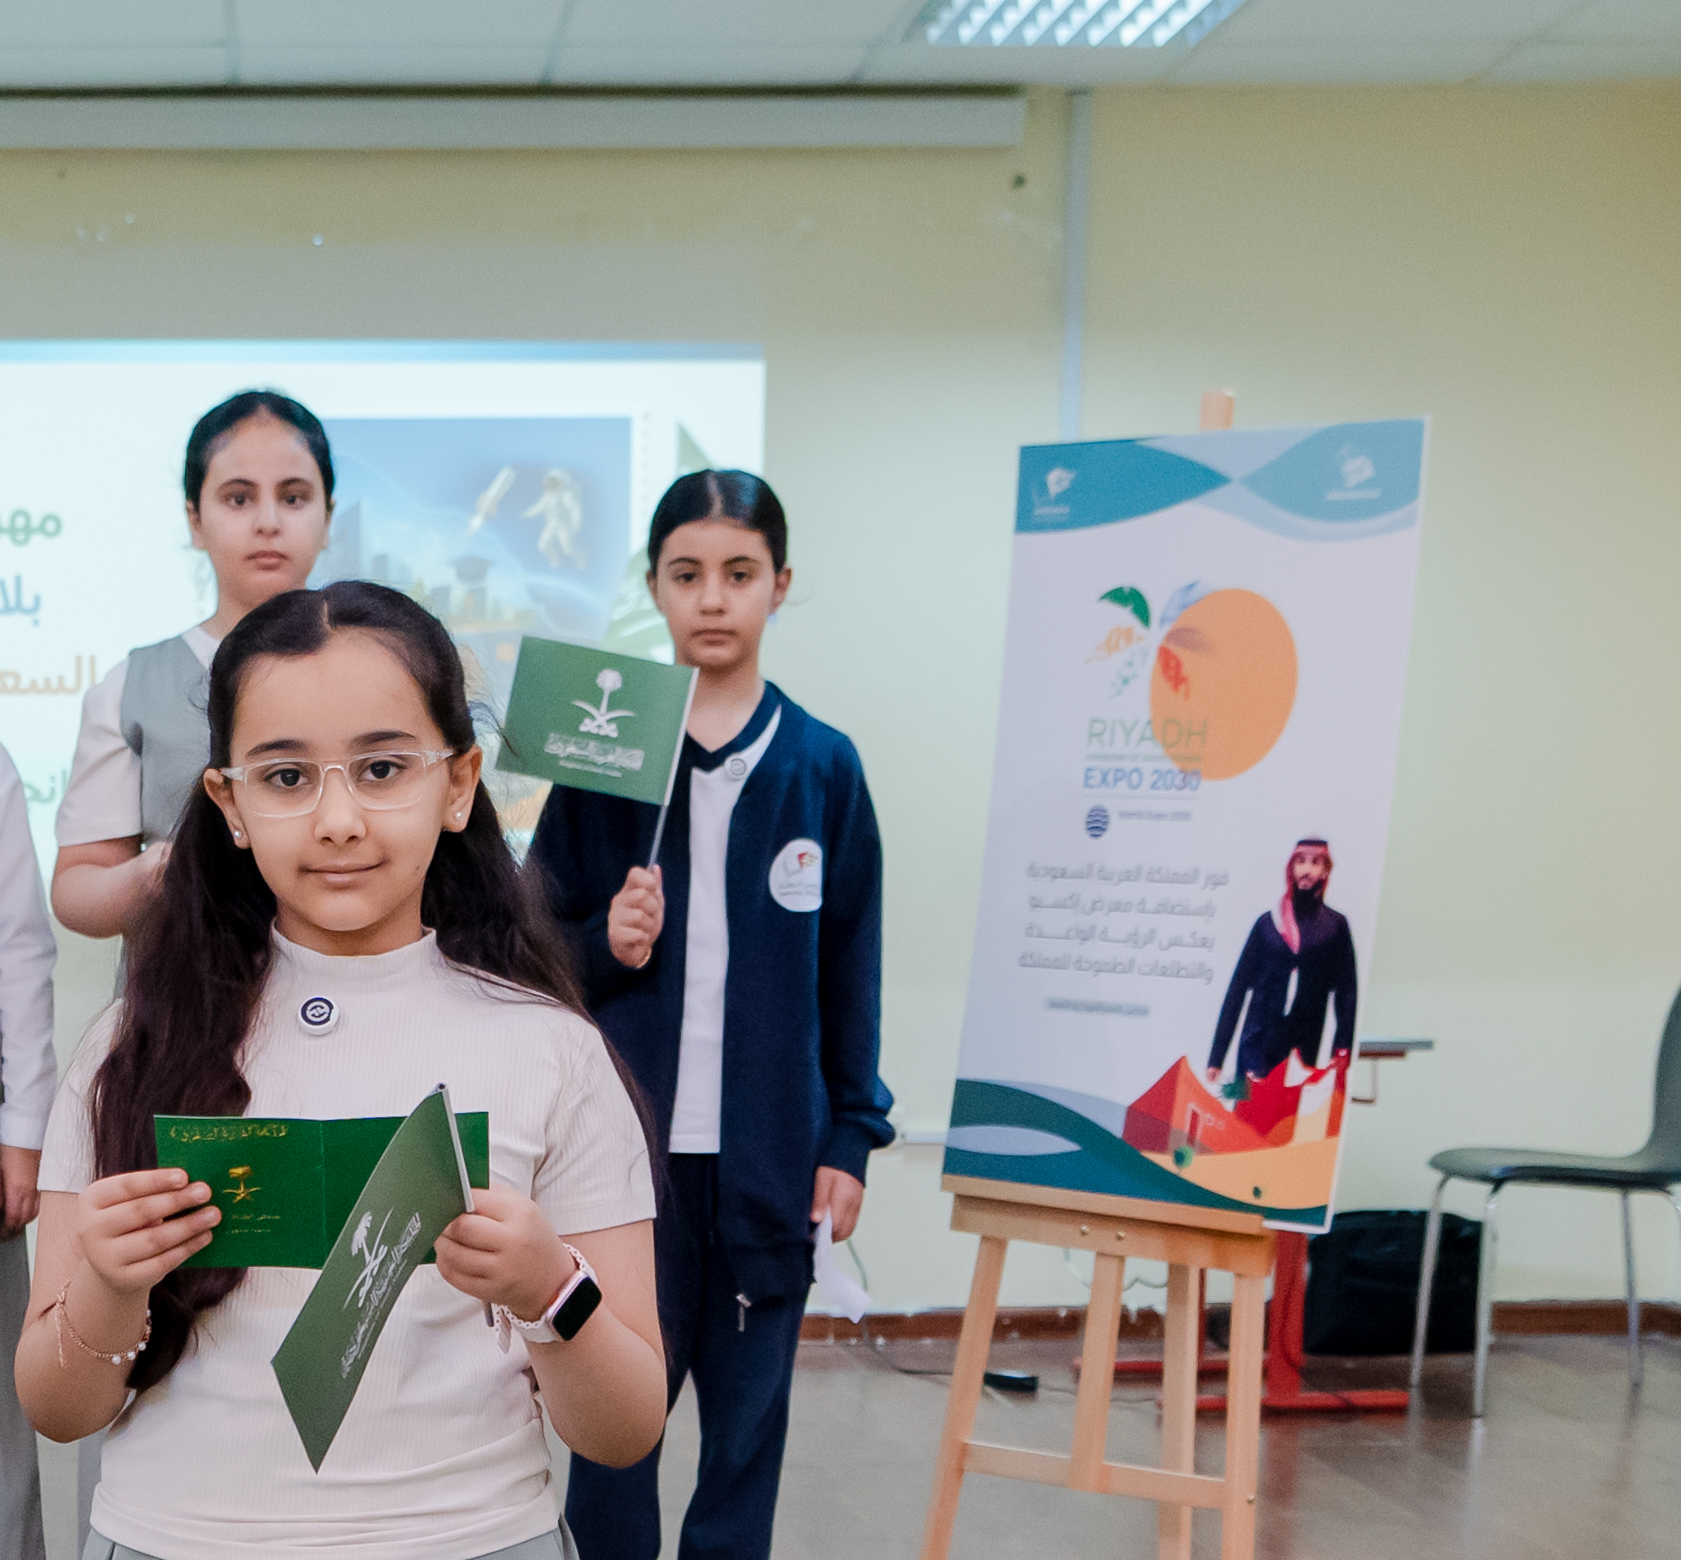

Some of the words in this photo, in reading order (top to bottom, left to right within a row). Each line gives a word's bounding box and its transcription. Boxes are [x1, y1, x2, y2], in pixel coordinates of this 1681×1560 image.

[1087, 717, 1208, 750] RIYADH
[1083, 766, 1144, 790] EXPO
[1150, 768, 1203, 792] 2030
[1026, 862, 1094, 883] السعودية
